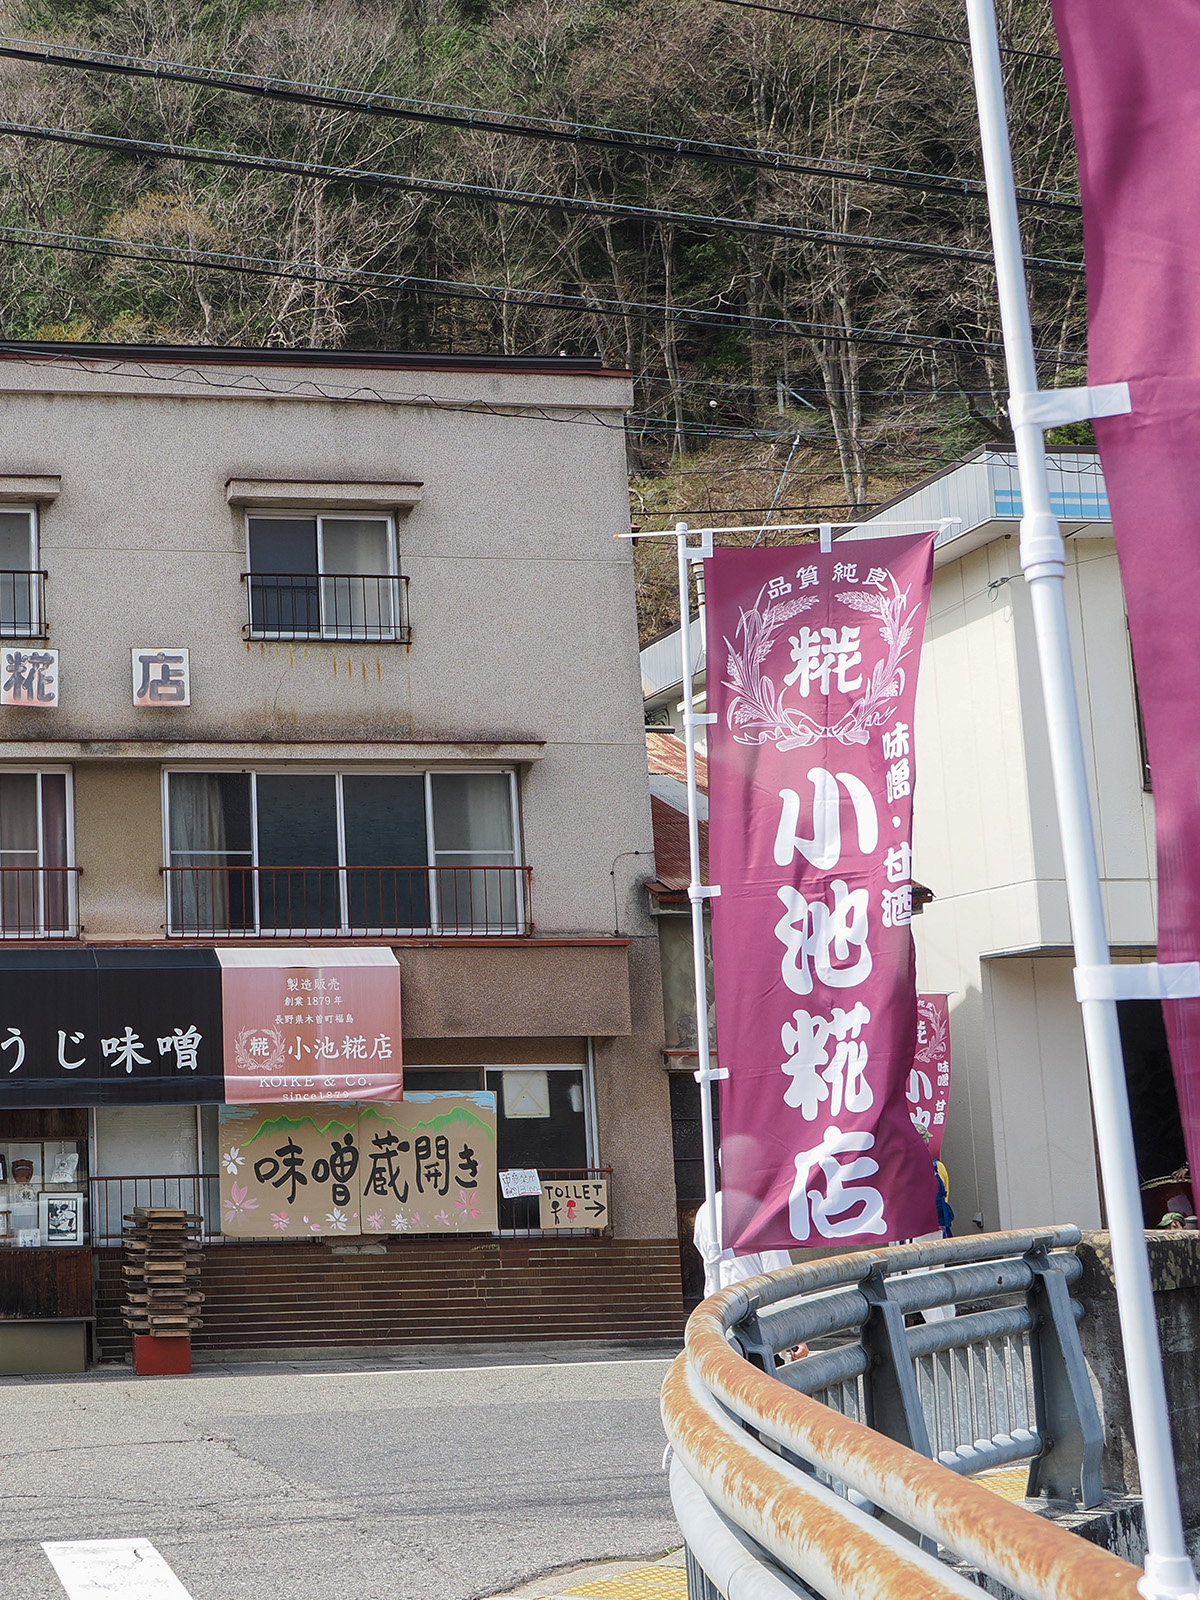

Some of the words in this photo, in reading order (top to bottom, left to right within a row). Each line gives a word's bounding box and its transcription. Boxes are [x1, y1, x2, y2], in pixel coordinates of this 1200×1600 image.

[767, 562, 888, 600] 品質純良
[783, 626, 863, 698] 糀
[286, 977, 340, 992] 製造販売
[773, 766, 888, 1242] 小池糀店
[249, 1036, 270, 1056] 糀
[288, 1033, 393, 1061] 小池糀店
[259, 1076, 314, 1088] KOIKE
[345, 1075, 372, 1087] Co.
[253, 1129, 481, 1206] 味噌蔵開き
[543, 1184, 603, 1200] TOILET
